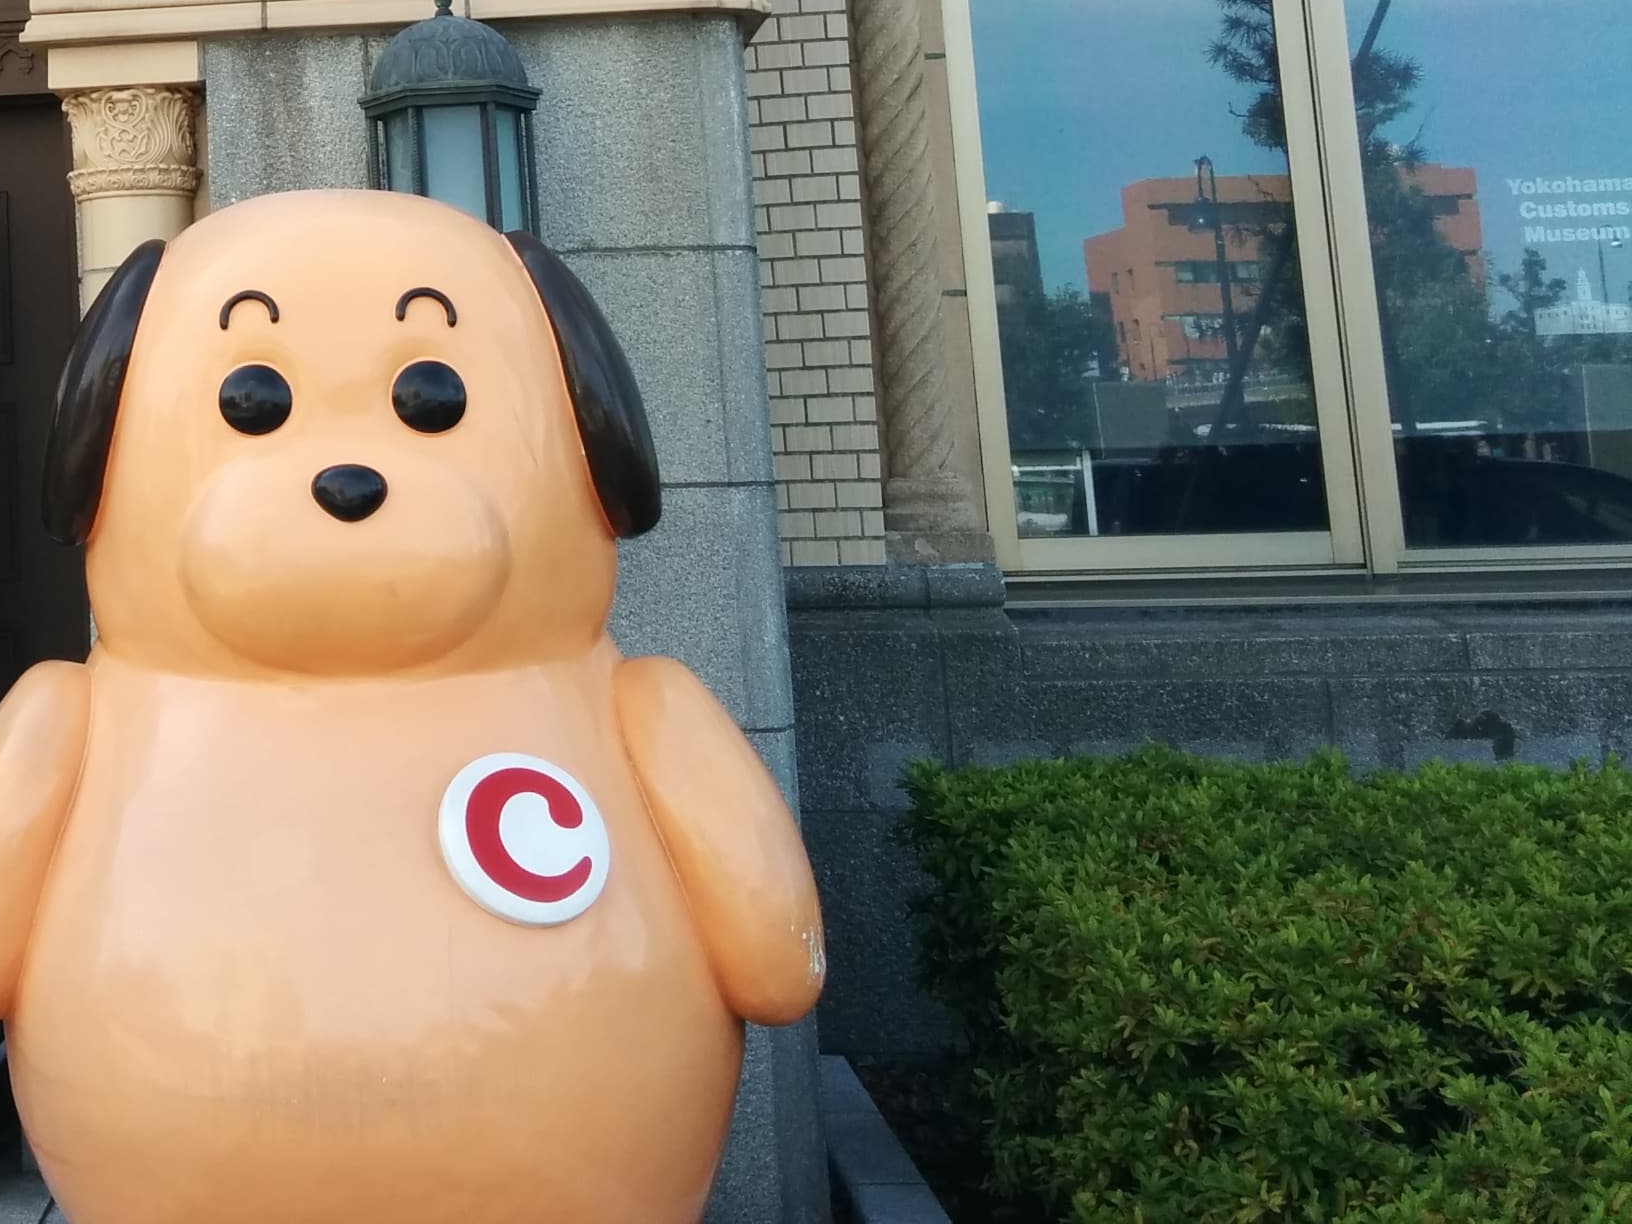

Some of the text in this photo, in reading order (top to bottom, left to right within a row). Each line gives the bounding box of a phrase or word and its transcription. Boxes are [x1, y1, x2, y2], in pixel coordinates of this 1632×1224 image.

[1519, 200, 1630, 219] Customs
[1524, 225, 1631, 243] Museum
[465, 767, 592, 903] C
